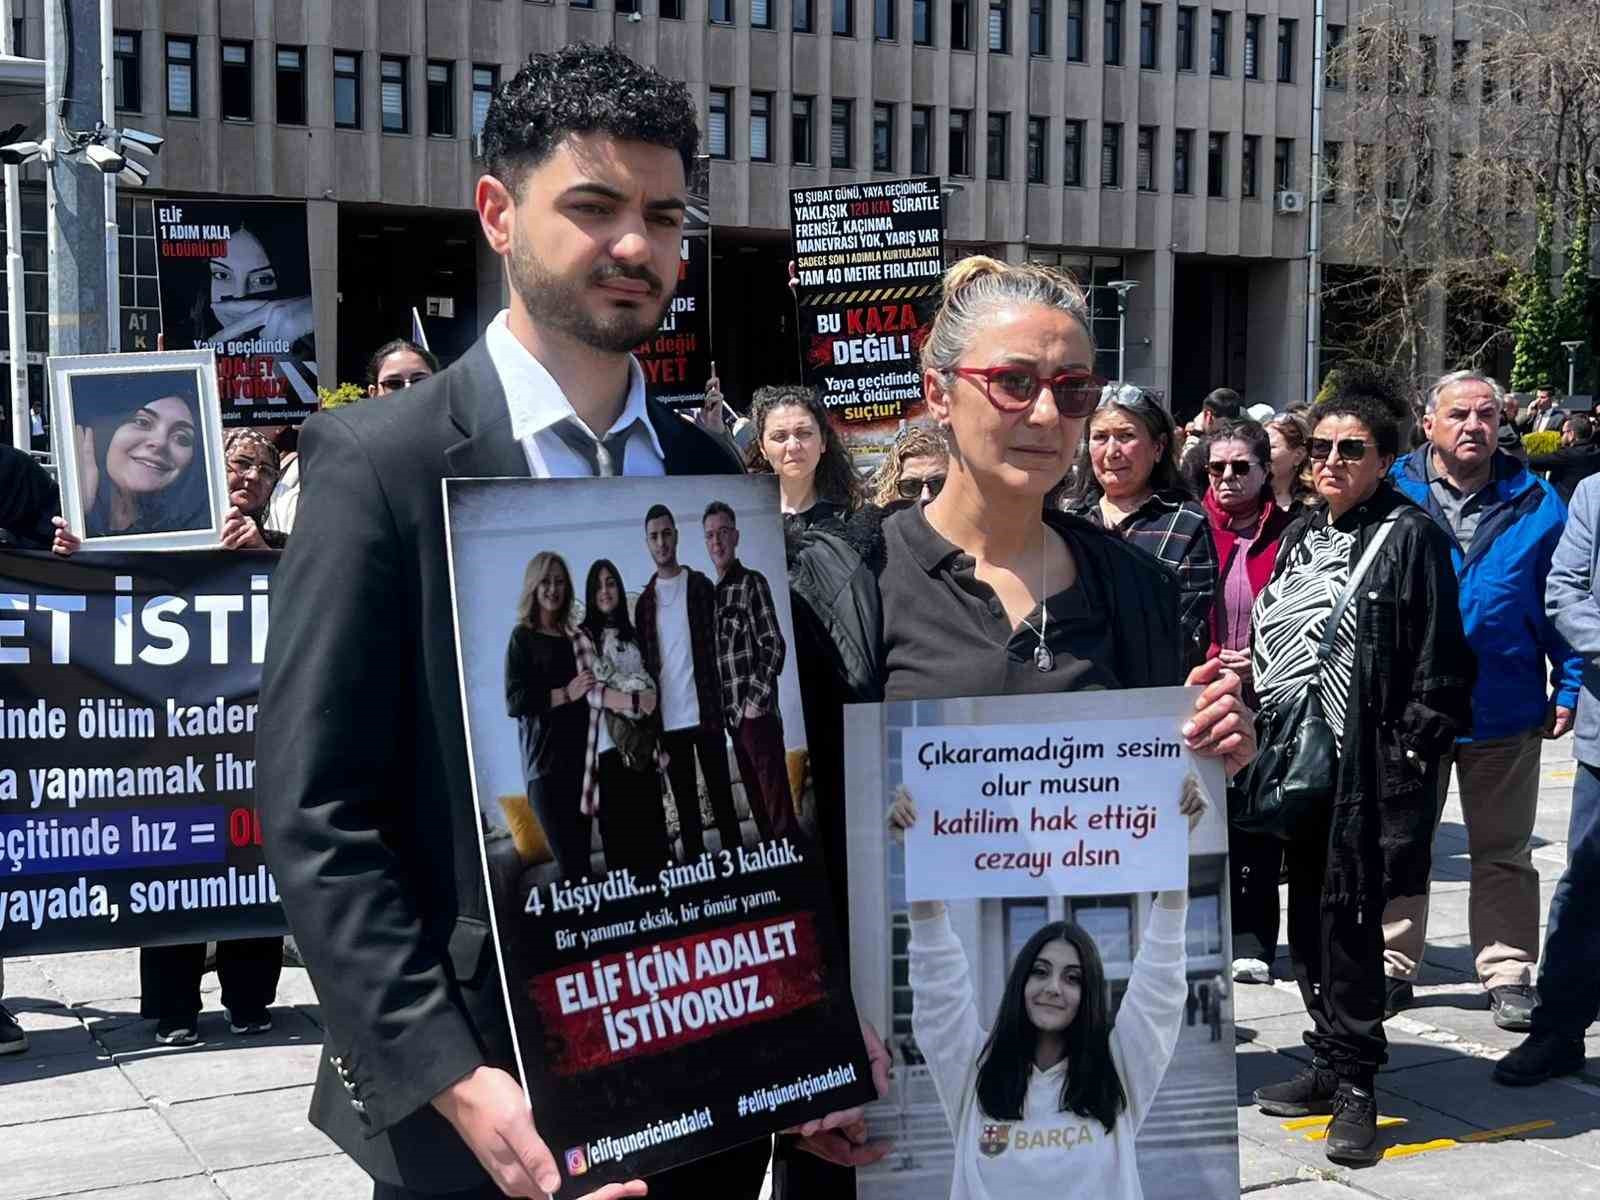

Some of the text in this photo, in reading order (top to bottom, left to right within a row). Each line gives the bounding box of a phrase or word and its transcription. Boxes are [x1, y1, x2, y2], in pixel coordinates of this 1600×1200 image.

[793, 192, 803, 204] 19
[805, 189, 833, 205] ŞUBAT
[835, 186, 862, 201] GÜNÜ,
[863, 186, 884, 198] YAYA
[159, 205, 182, 223] ELİF
[795, 196, 940, 222] YAKLAŞIK 120 KM SÜRATLE
[160, 225, 231, 240] 1 ADIM KALA
[796, 216, 893, 238] FRENSİZ, KAÇINMA
[162, 239, 228, 256] ÖLDÜRÜLDÜ
[796, 228, 939, 254] MANEVRASI YOK, YARIŞ VAR
[798, 254, 828, 268] SADECE
[828, 252, 845, 265] SON
[851, 250, 881, 264] ADIMLA
[882, 246, 939, 261] KURTULACAKTI
[798, 260, 941, 286] TAM 40 METRE FIRLATILDI
[129, 312, 147, 330] A1
[817, 303, 918, 335] BU KAZA
[227, 338, 290, 357] geçidinde
[642, 356, 688, 384] YET
[825, 371, 920, 391] Yaya geçidinde
[823, 386, 921, 408] çocuk öldürmek
[844, 402, 902, 421] suçtur!
[114, 575, 269, 665] İSTİ
[78, 698, 155, 739] ölüm
[167, 697, 258, 738] kader
[918, 736, 1181, 770] Çıkaramadığım sesim
[29, 756, 205, 809] yapmamak
[982, 773, 1119, 797] olur musun
[933, 805, 1156, 839] katilim hak ettiği
[0, 817, 120, 872] çitinde
[132, 815, 177, 853] hız
[975, 840, 1120, 877] cezayı alsın
[524, 838, 803, 915] 4 kişiydik... şimdi 3 kaldık.
[555, 889, 781, 950] Bir yanımız eksik, bir ömür yarım.
[555, 921, 797, 1015] ELİF İÇİN ADALET
[602, 974, 774, 1052] İSTİYORUZ.
[737, 1062, 857, 1117] #elifgüneriçinadalet
[1015, 1125, 1093, 1152] BARÇA
